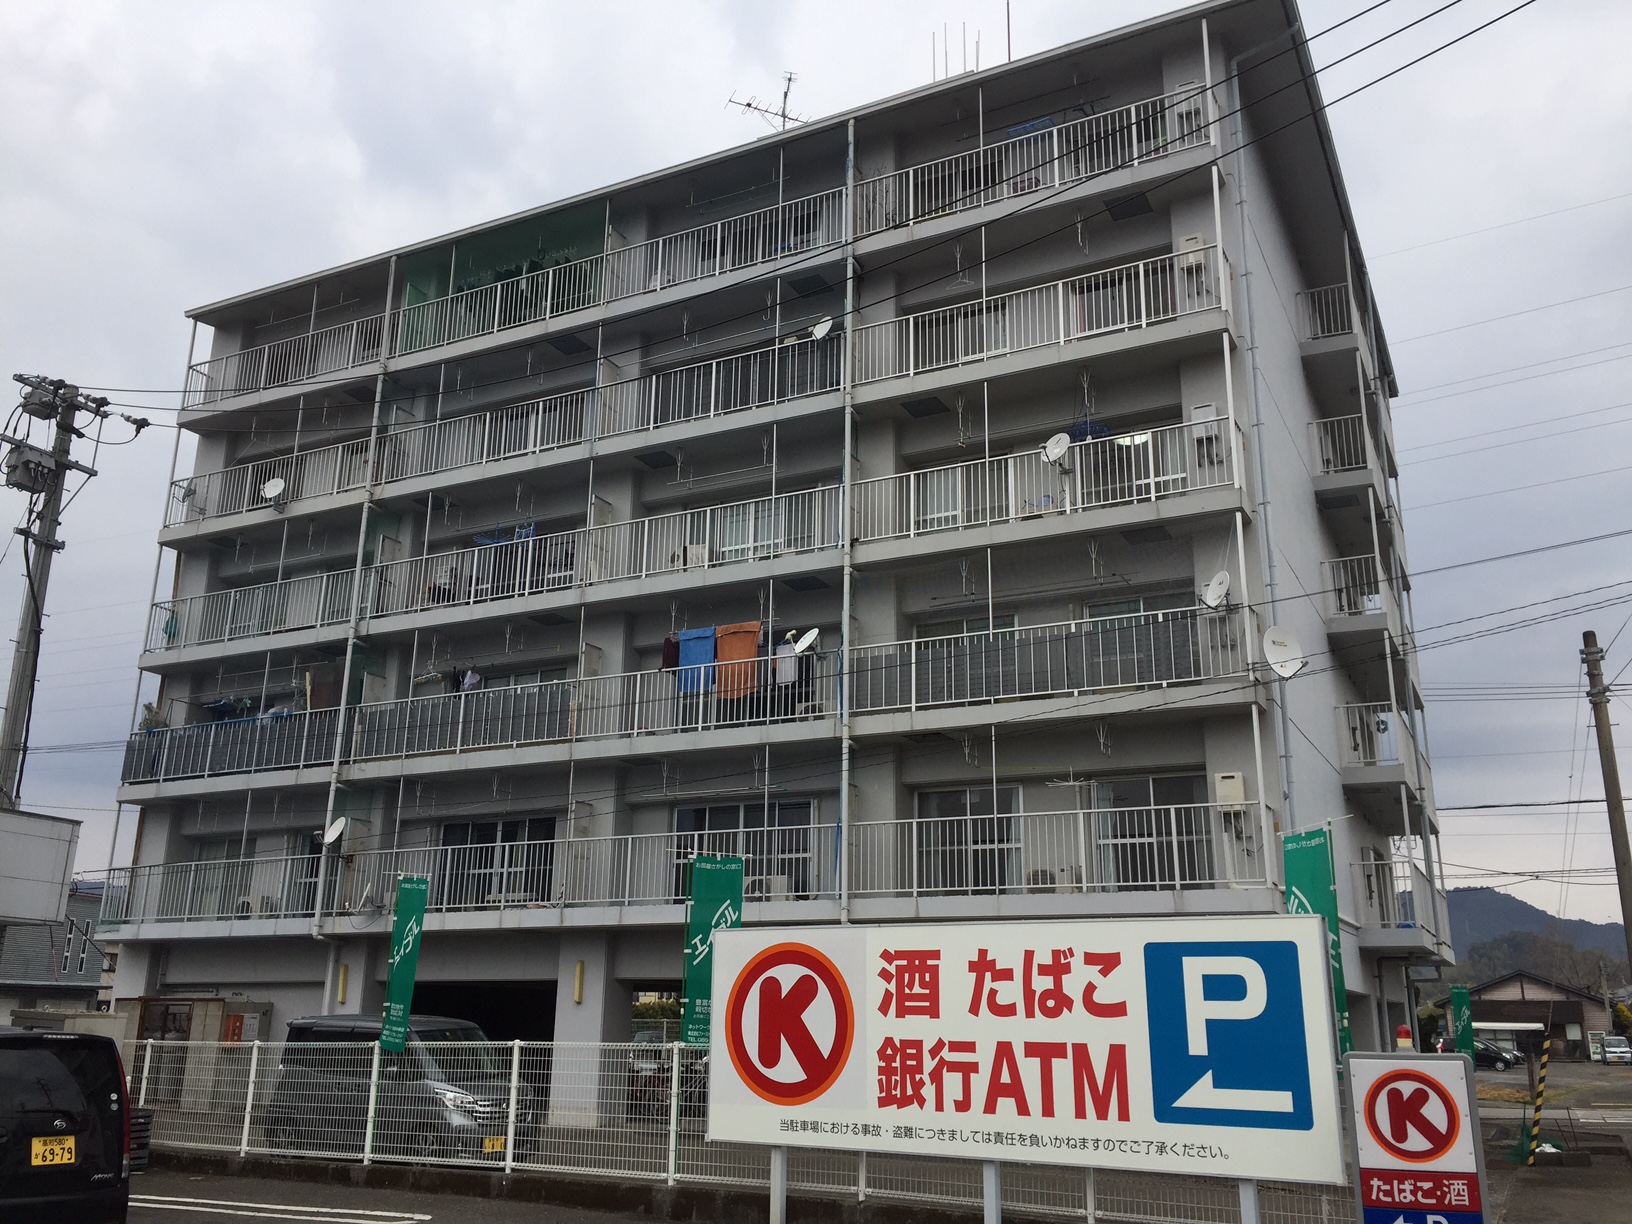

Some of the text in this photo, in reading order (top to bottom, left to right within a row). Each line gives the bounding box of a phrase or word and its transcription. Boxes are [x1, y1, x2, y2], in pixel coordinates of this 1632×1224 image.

[878, 948, 1128, 1019] 酒 たばこ
[1182, 956, 1268, 1056] P
[877, 1037, 1130, 1122] 銀行ATM
[779, 1118, 1230, 1160] 当駐車場における事故・盗難につきましては責任を負いかねますのでご了承ください。
[1370, 1177, 1470, 1206] たばこ・酒
